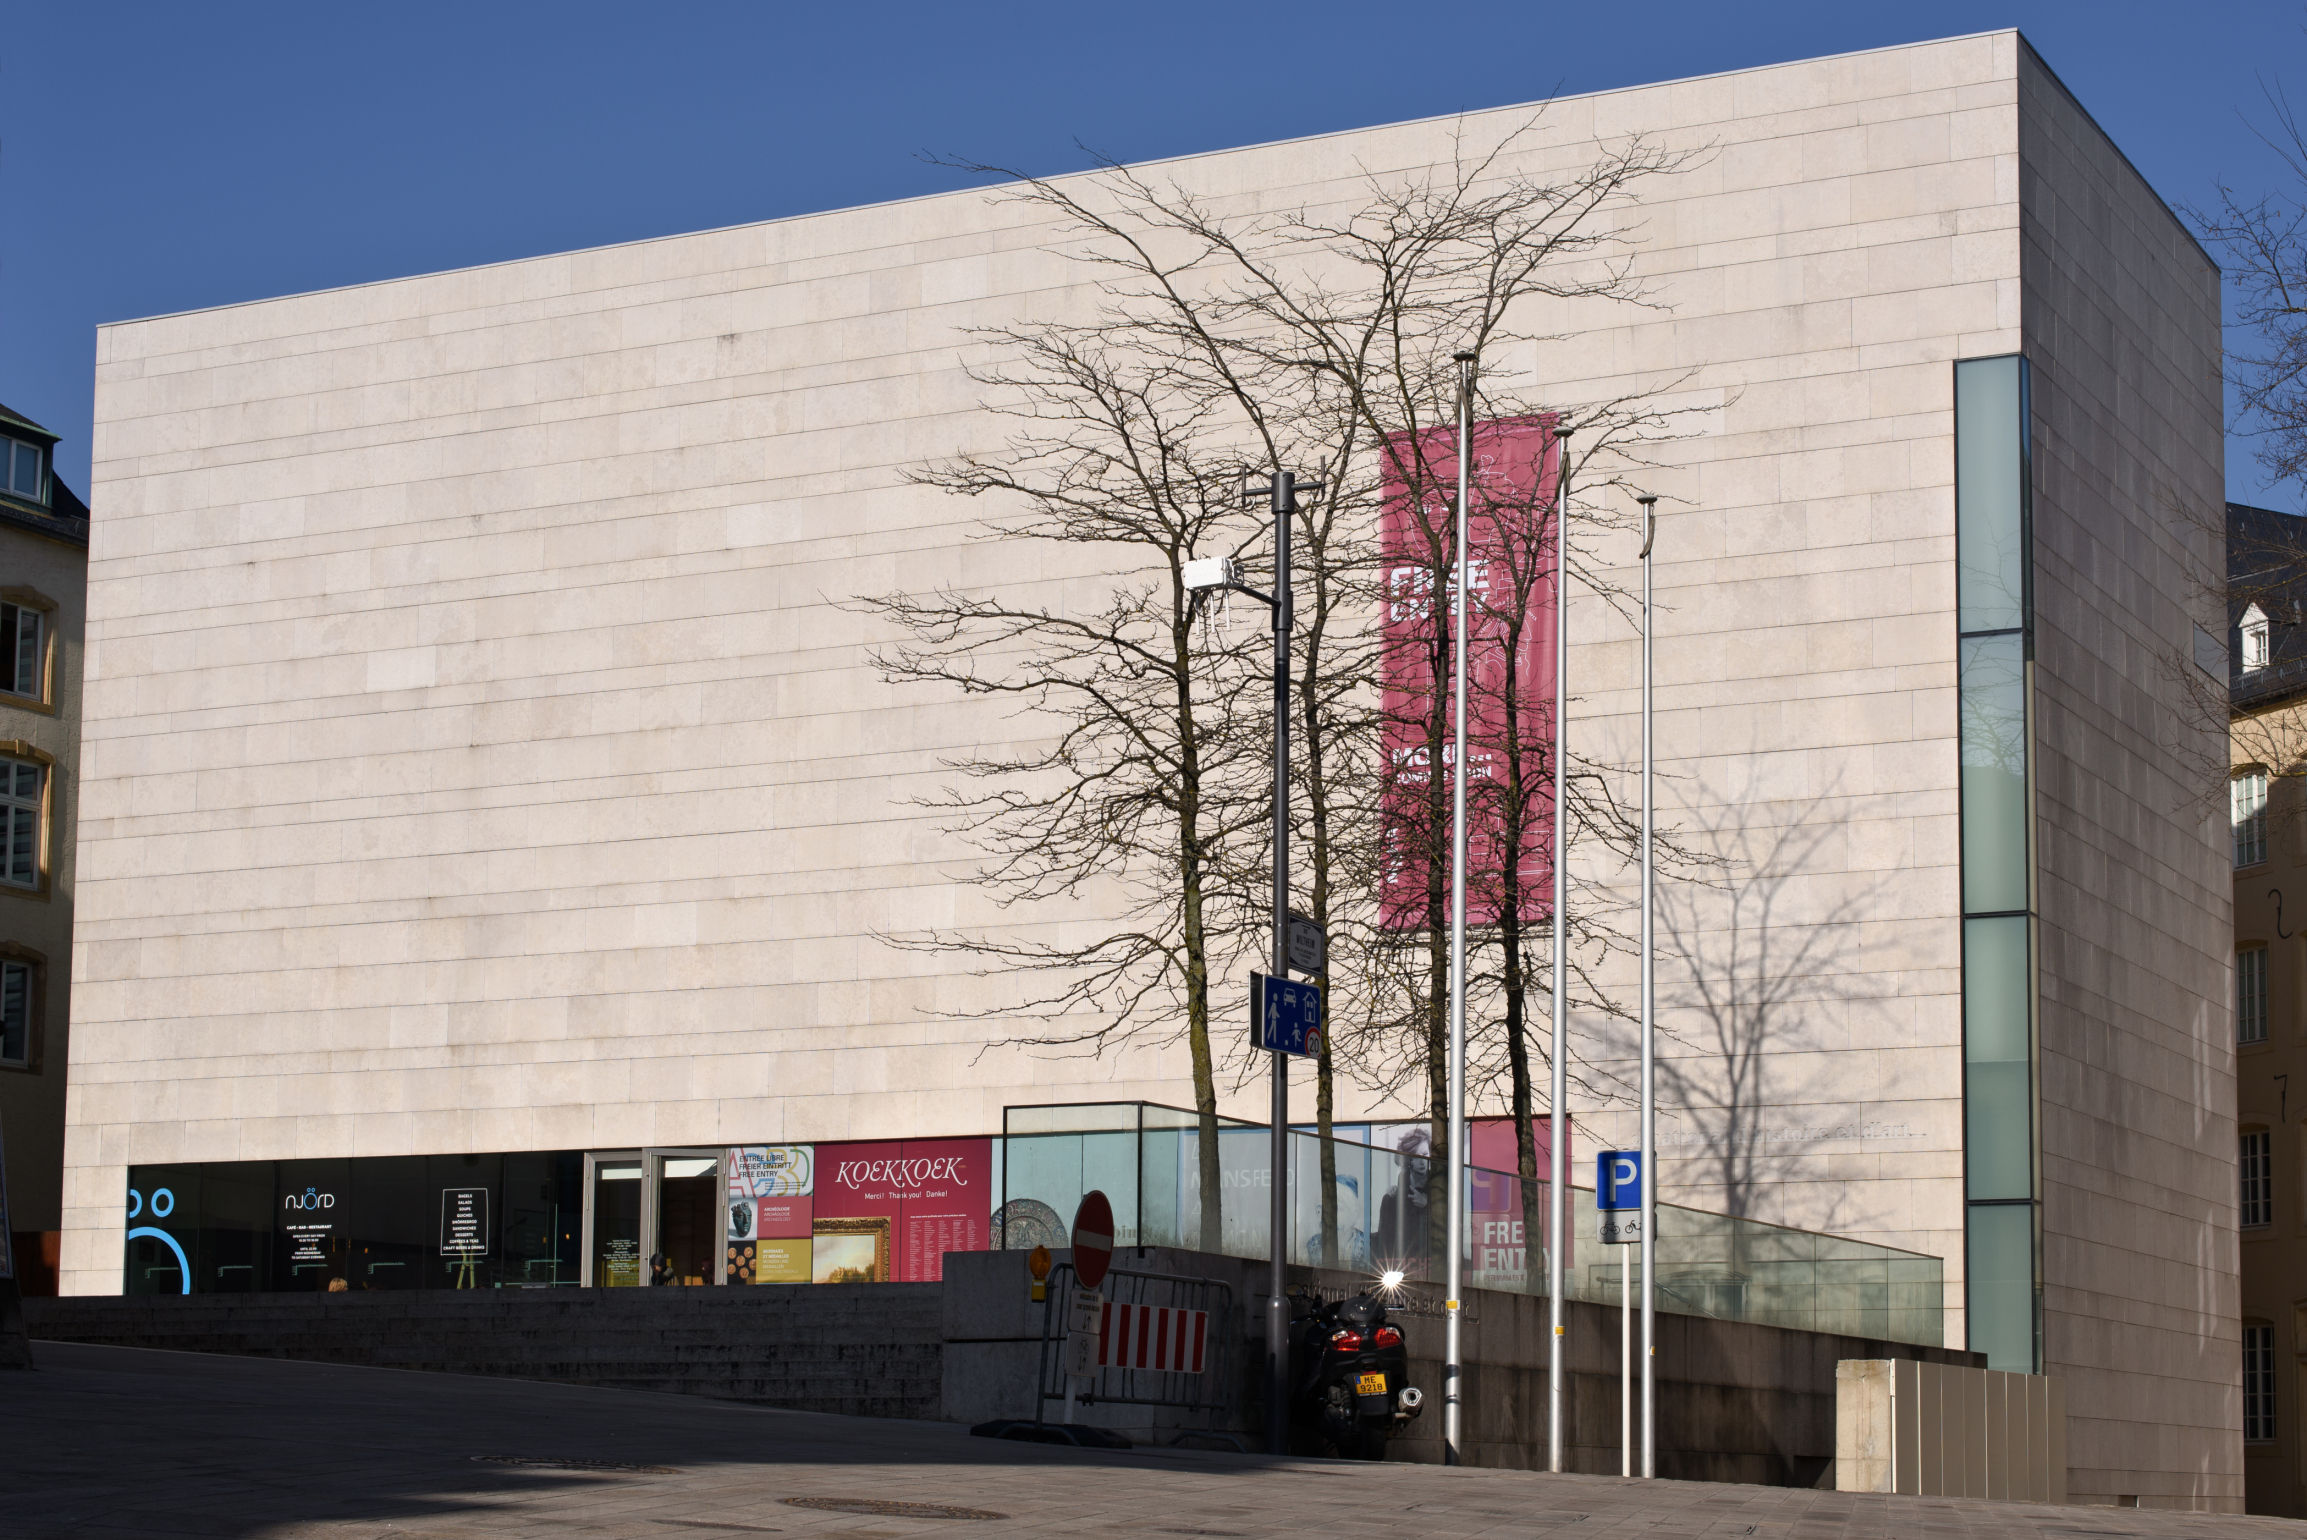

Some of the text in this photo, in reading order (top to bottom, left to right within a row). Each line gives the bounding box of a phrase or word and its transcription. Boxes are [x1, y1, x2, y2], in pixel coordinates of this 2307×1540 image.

[1310, 1037, 1320, 1053] 20
[835, 1157, 968, 1190] KOEKKOEK
[1609, 1159, 1637, 1202] P
[864, 1192, 885, 1200] Merci!
[908, 1191, 922, 1199] you!
[926, 1190, 948, 1198] Danke!
[1484, 1221, 1524, 1245] FRE
